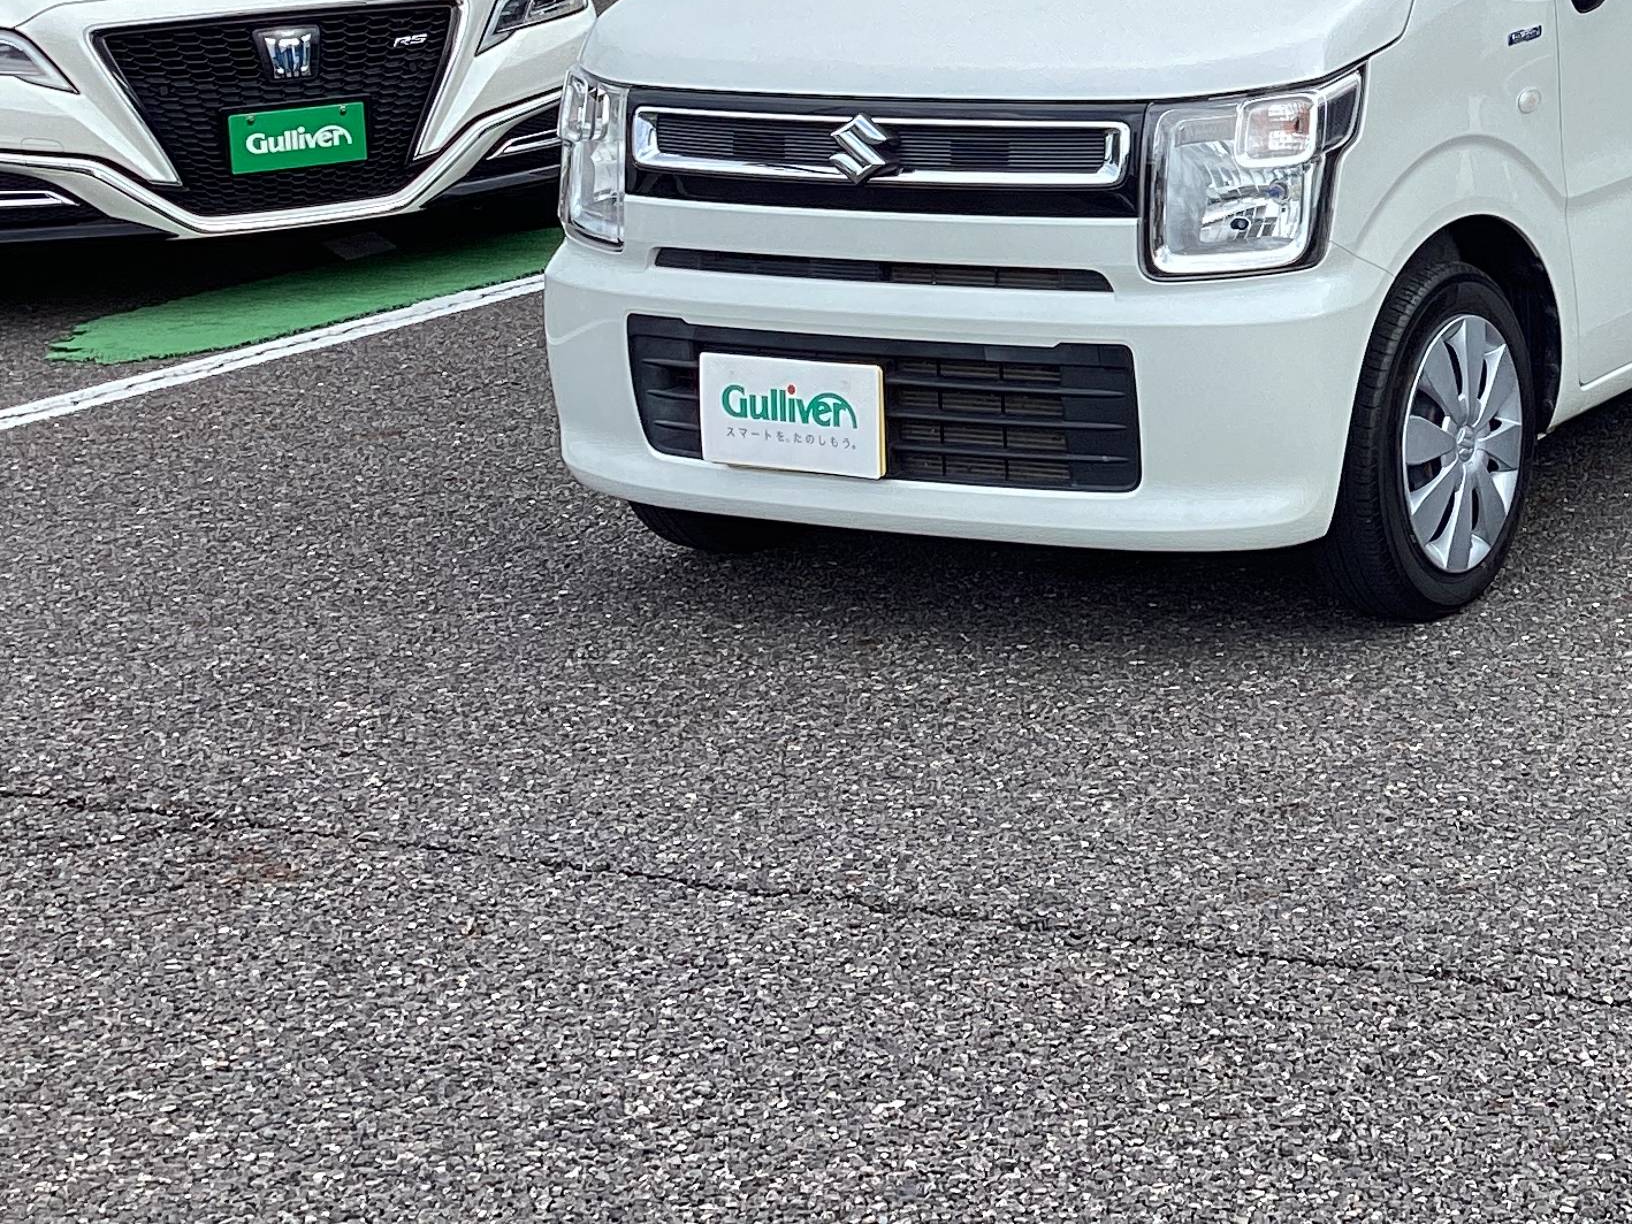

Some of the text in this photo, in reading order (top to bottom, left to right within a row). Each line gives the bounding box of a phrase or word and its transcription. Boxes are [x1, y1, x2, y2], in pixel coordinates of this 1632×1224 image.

[393, 33, 428, 48] RS
[245, 124, 353, 155] Gulliver
[721, 384, 858, 430] Gulliver
